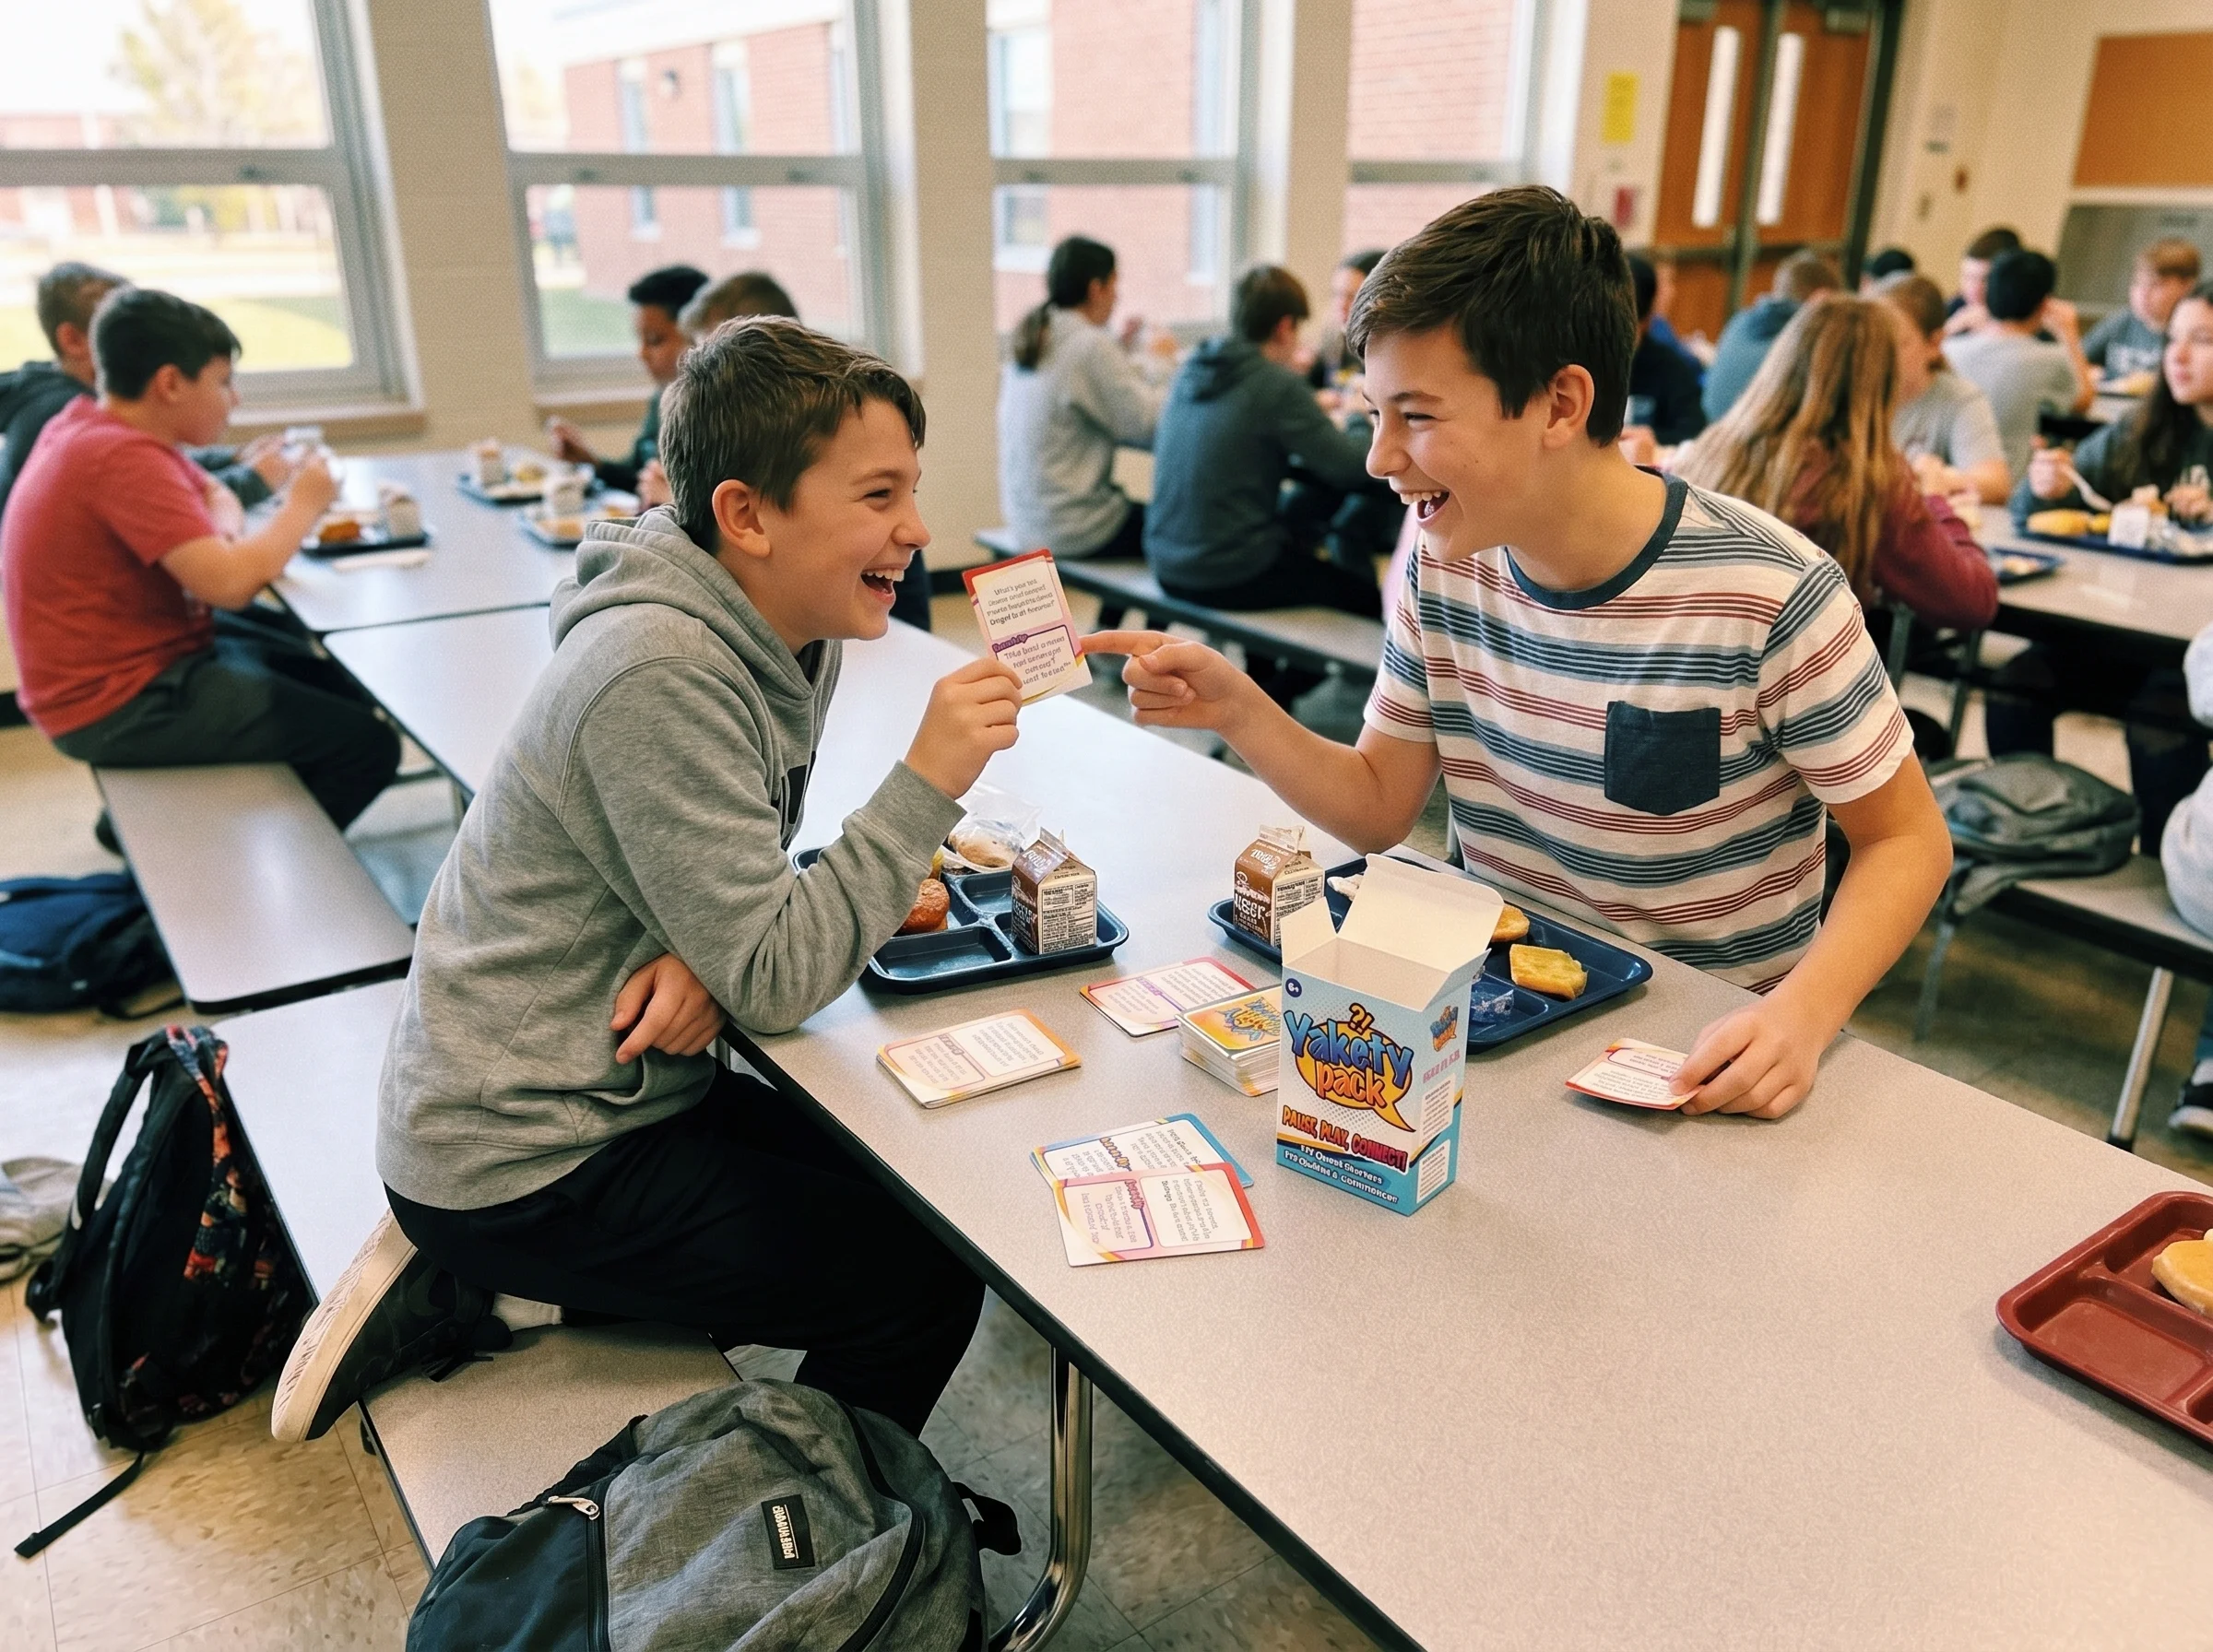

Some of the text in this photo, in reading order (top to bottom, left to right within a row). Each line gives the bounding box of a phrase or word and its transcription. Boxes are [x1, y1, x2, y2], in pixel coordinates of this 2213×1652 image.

[1284, 1009, 1414, 1090] Yakety
[1315, 1060, 1388, 1108] pack
[1282, 1104, 1318, 1139] PAUSE,
[1320, 1119, 1349, 1151] PLAY,
[1351, 1133, 1408, 1173] CONNECT!
